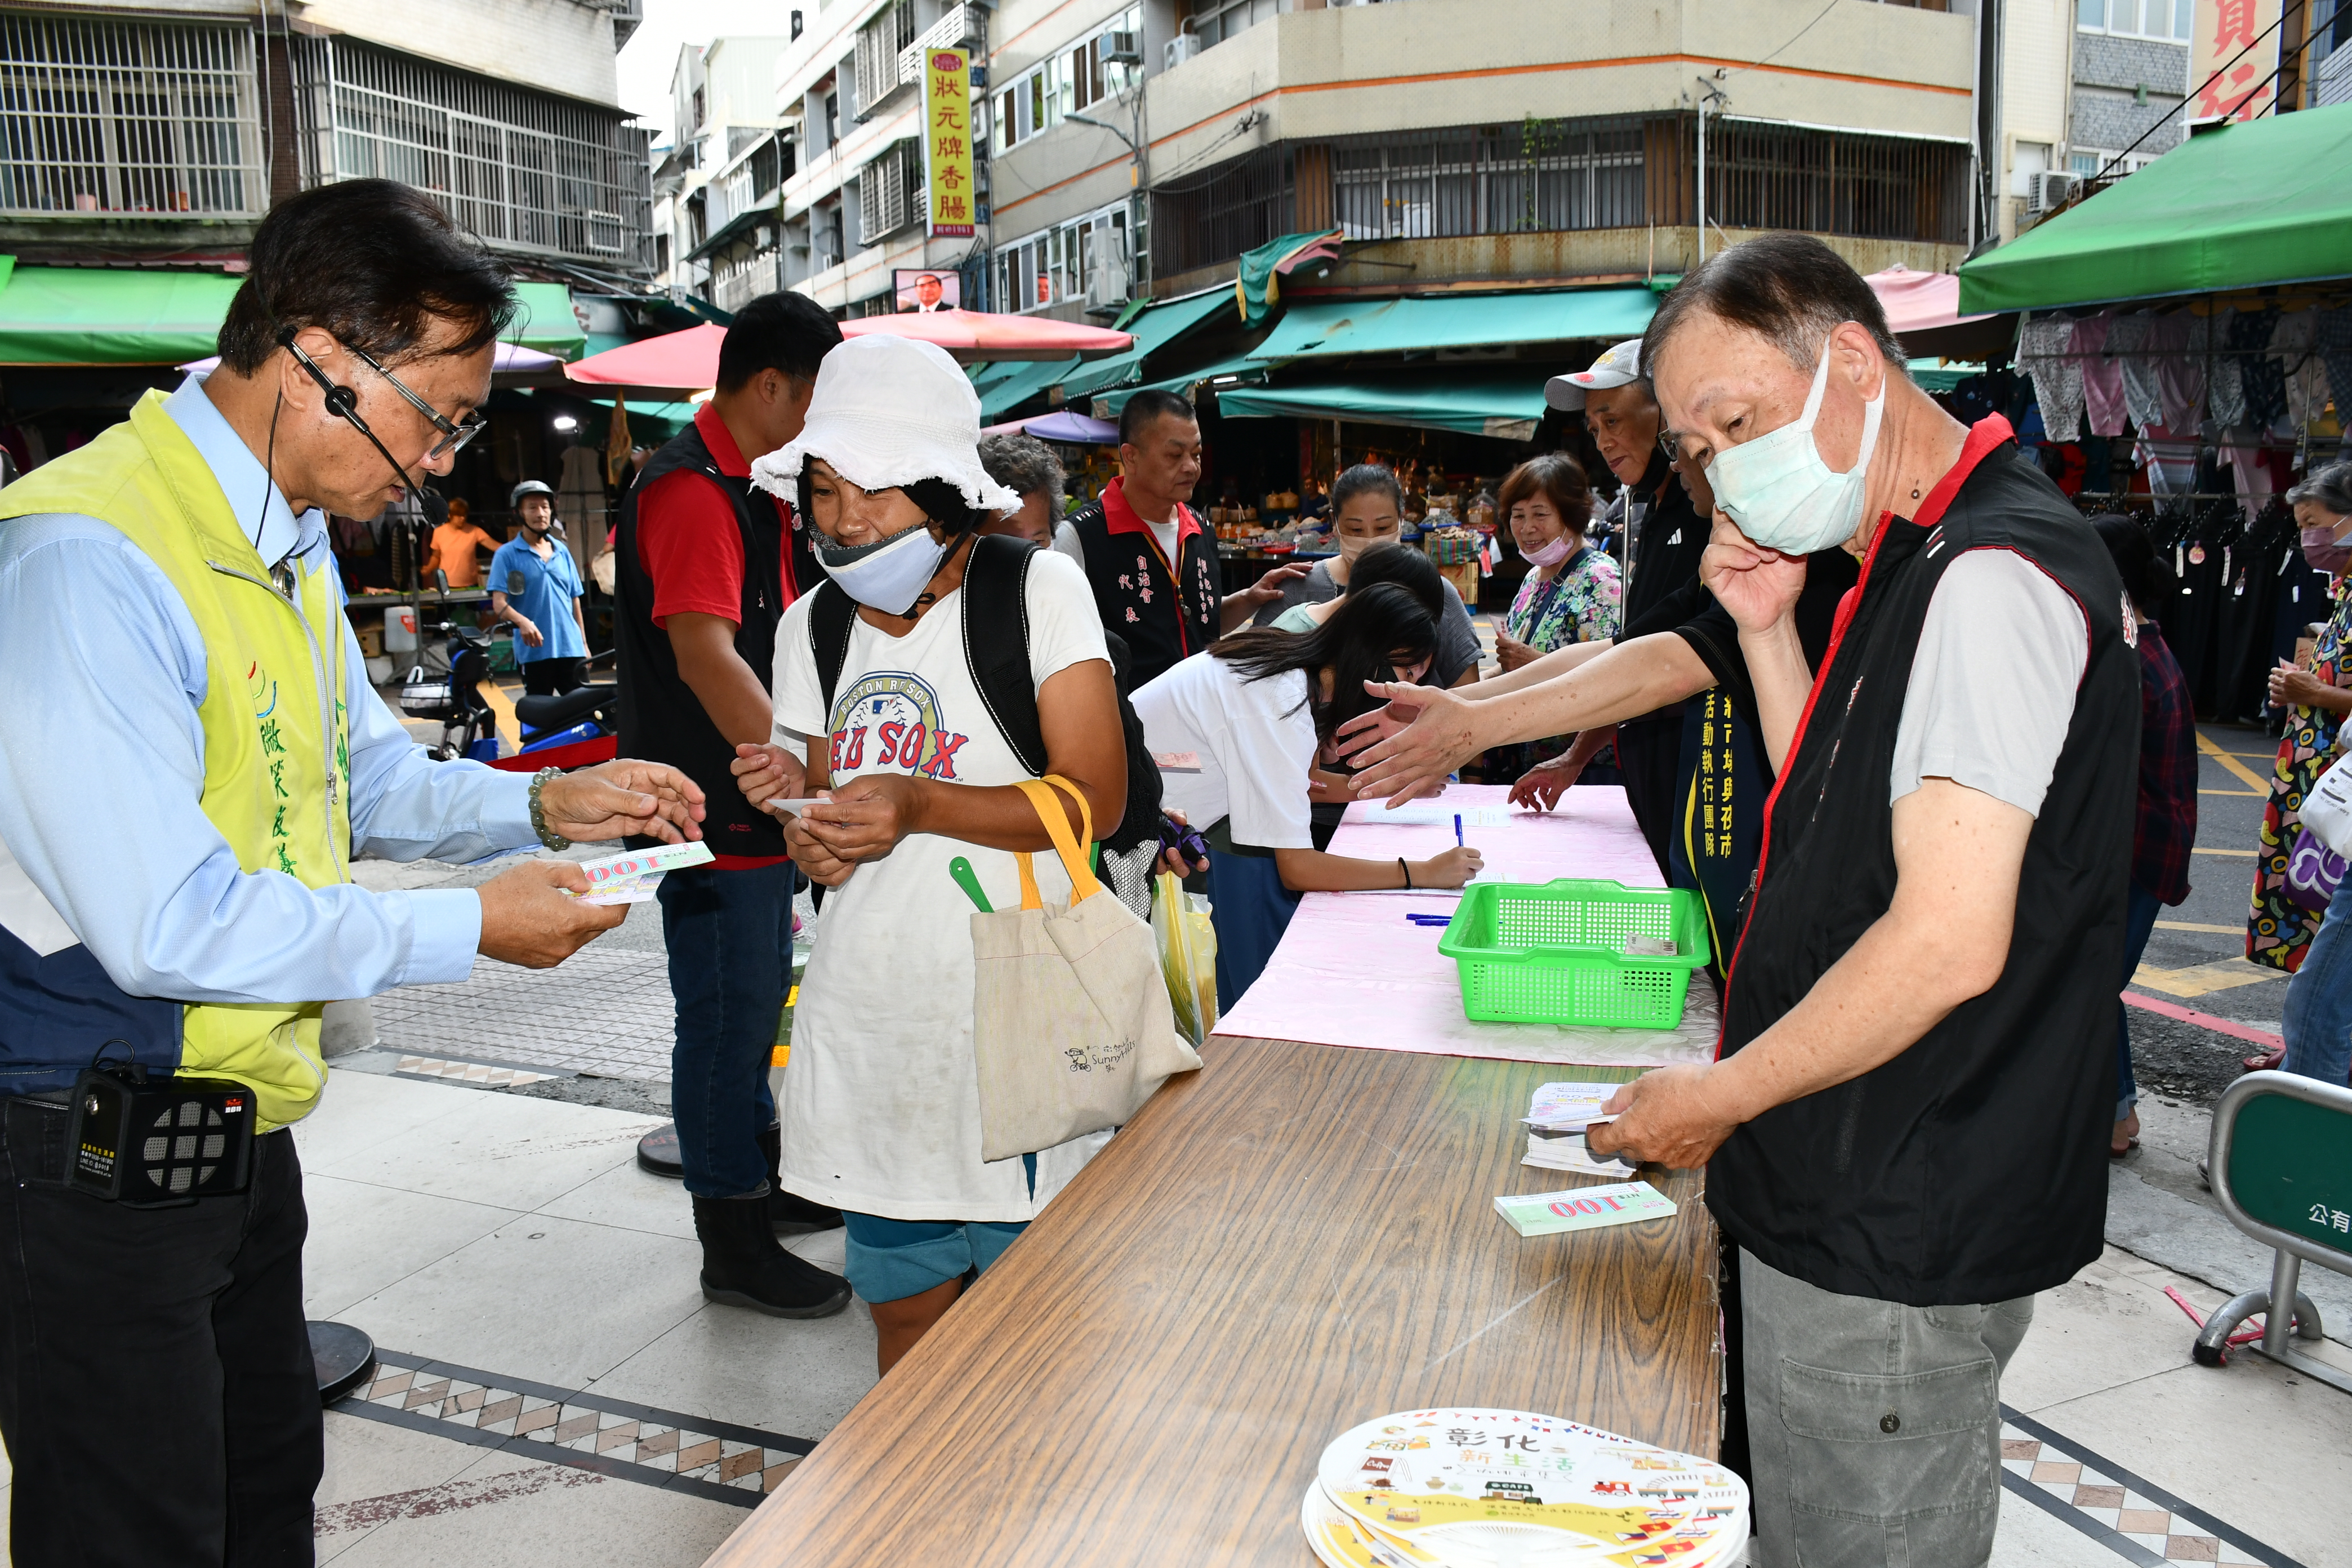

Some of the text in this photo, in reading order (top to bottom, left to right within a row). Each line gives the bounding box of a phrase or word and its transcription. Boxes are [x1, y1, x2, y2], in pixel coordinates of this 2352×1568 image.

[934, 75, 966, 220] 狀元牌香腸
[1137, 555, 1154, 603] 自治會
[1118, 574, 1140, 623] 代表
[840, 679, 931, 716] BOSTON RE SOX
[827, 720, 969, 779] ED SOX
[1702, 687, 1716, 858] 活動執行團隊
[585, 856, 665, 883] 100
[1663, 941, 1673, 952] 100
[1092, 1040, 1135, 1065] SunnyHills
[1548, 1195, 1629, 1218] 100
[2309, 1203, 2352, 1233] 公有
[1446, 1428, 1540, 1453] 彰化
[1459, 1449, 1576, 1471] 新生活
